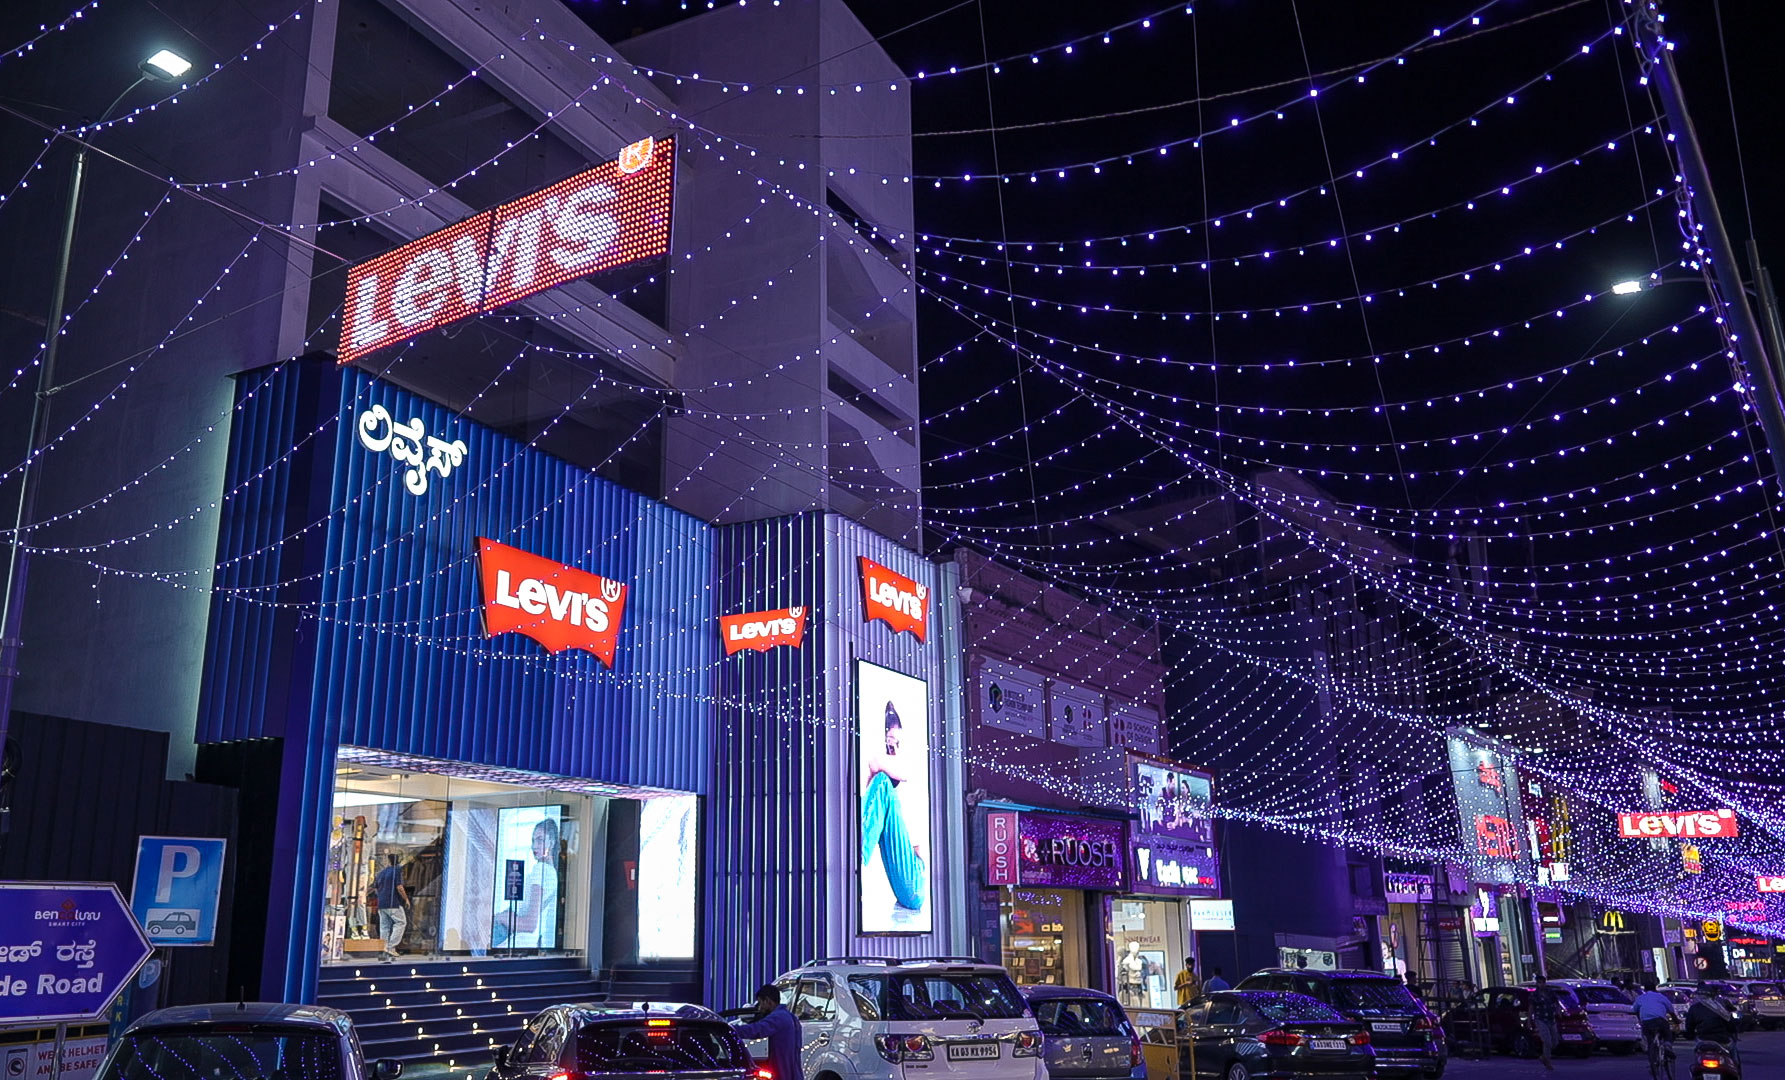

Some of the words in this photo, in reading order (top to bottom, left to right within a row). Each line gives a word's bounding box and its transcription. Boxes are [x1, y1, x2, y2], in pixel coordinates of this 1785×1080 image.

[994, 817, 1007, 881] RUOSH
[1052, 838, 1116, 867] RUOSH
[155, 844, 201, 904] P
[56, 939, 97, 968] ರಸ್ತೆ
[36, 972, 104, 995] Road
[68, 1044, 105, 1058] HELMET
[74, 1059, 97, 1070] SAFE
